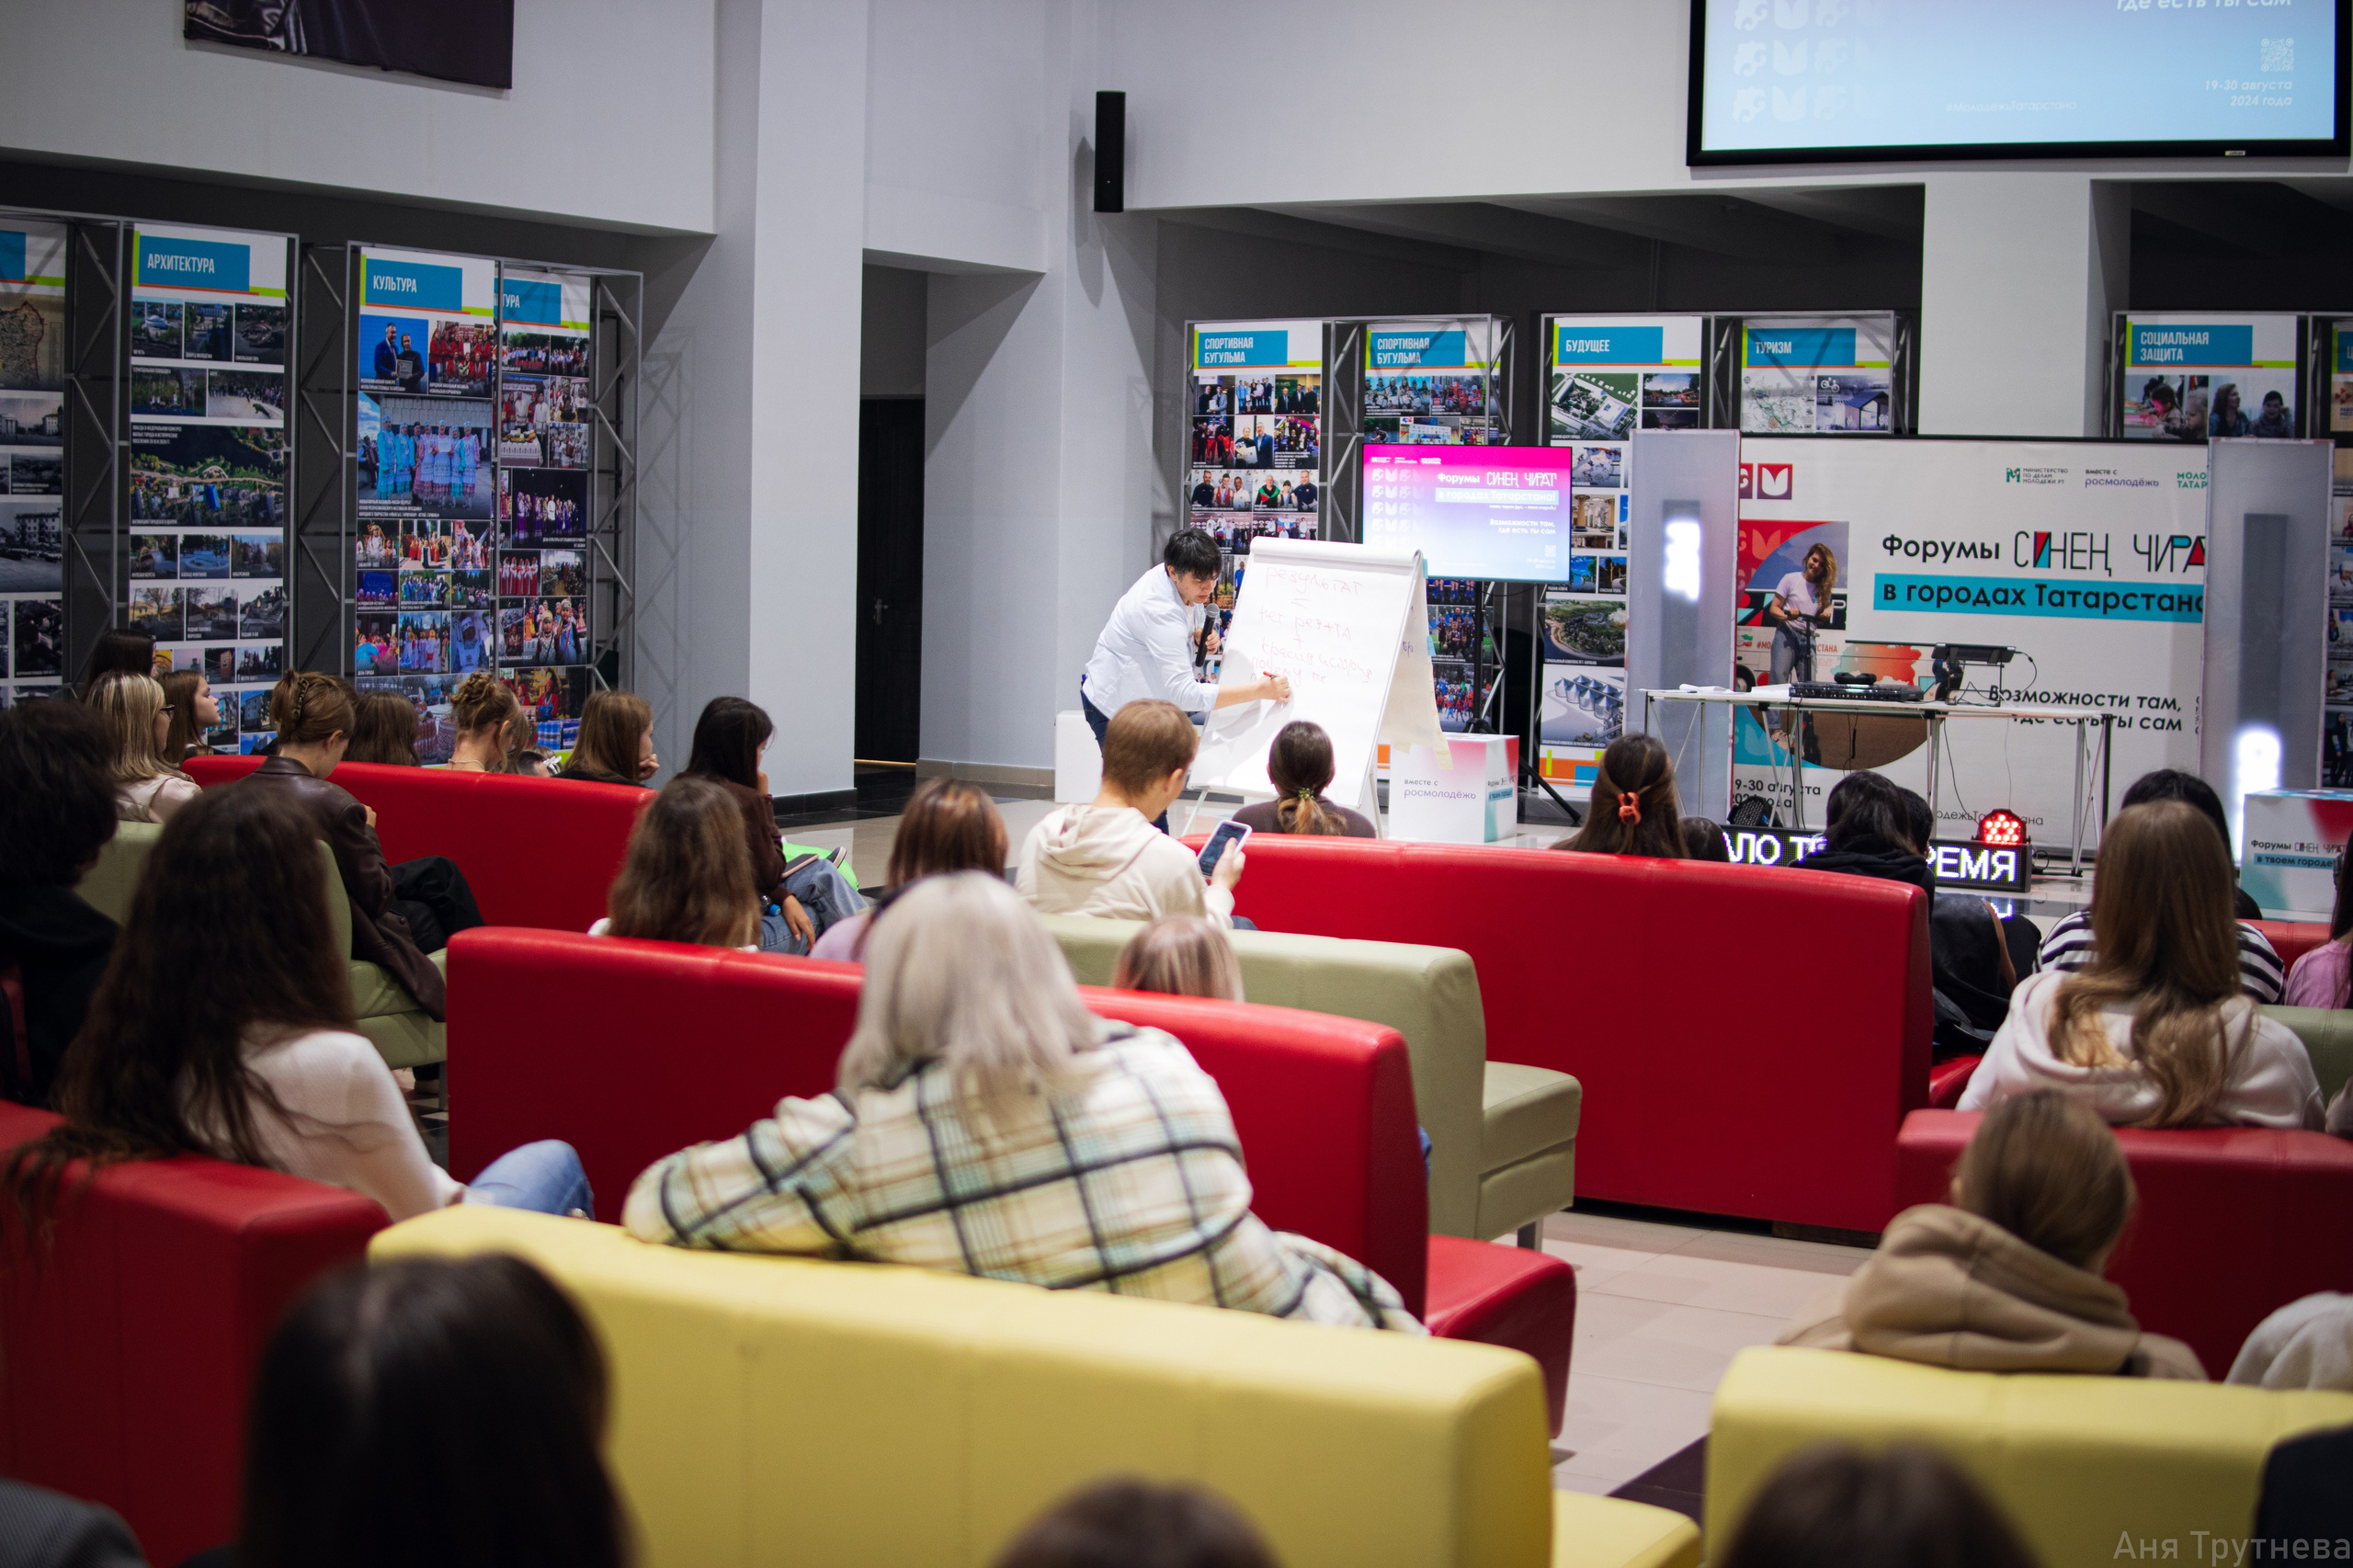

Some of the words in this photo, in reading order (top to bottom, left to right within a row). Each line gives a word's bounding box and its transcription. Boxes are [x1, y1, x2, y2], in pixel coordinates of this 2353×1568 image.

[2206, 80, 2237, 91] 19-30
[2241, 80, 2292, 93] августа
[2230, 95, 2258, 107] 2024
[2262, 97, 2292, 107] года
[147, 253, 215, 274] АРХИТЕКТУРА
[373, 275, 417, 293] КУЛЬТУРА
[1204, 336, 1254, 349] СПОРТИВНАЯ
[1377, 337, 1430, 350] СПОРТИВНАЯ
[2140, 331, 2210, 346] СОЦИАЛЬНАЯ
[1565, 339, 1610, 353] БУДУЩЕЕ
[1755, 341, 1792, 354] ТУРИЗМ
[1204, 351, 1245, 363] БУГУЛЬМА
[1377, 352, 1422, 364] БУГУЛЬМА
[2140, 347, 2184, 362] ЗАЩИТА
[1438, 473, 1481, 485] Форумы
[2085, 477, 2159, 488] росмолодёжь
[2177, 472, 2207, 480] МОЛО
[2177, 480, 2208, 489] ТАТАР
[1447, 491, 1489, 503] городах
[1491, 490, 1556, 503] Татарстана!
[1489, 517, 1539, 526] Возможности
[1882, 534, 2000, 563] Форумы
[2014, 530, 2112, 577] СИНЕҢ
[2133, 533, 2205, 573] ЧИРА
[1883, 584, 1896, 600] в
[1906, 583, 2026, 608] городах
[1756, 641, 1771, 650] #МО
[1988, 685, 2130, 708] Возможности
[2136, 696, 2182, 712] там,
[2140, 717, 2182, 731] сам
[1734, 778, 1764, 790] 9-30
[1404, 789, 1476, 800] росмолодёжь
[2251, 839, 2291, 850] Форумы
[2265, 856, 2295, 865] твоем
